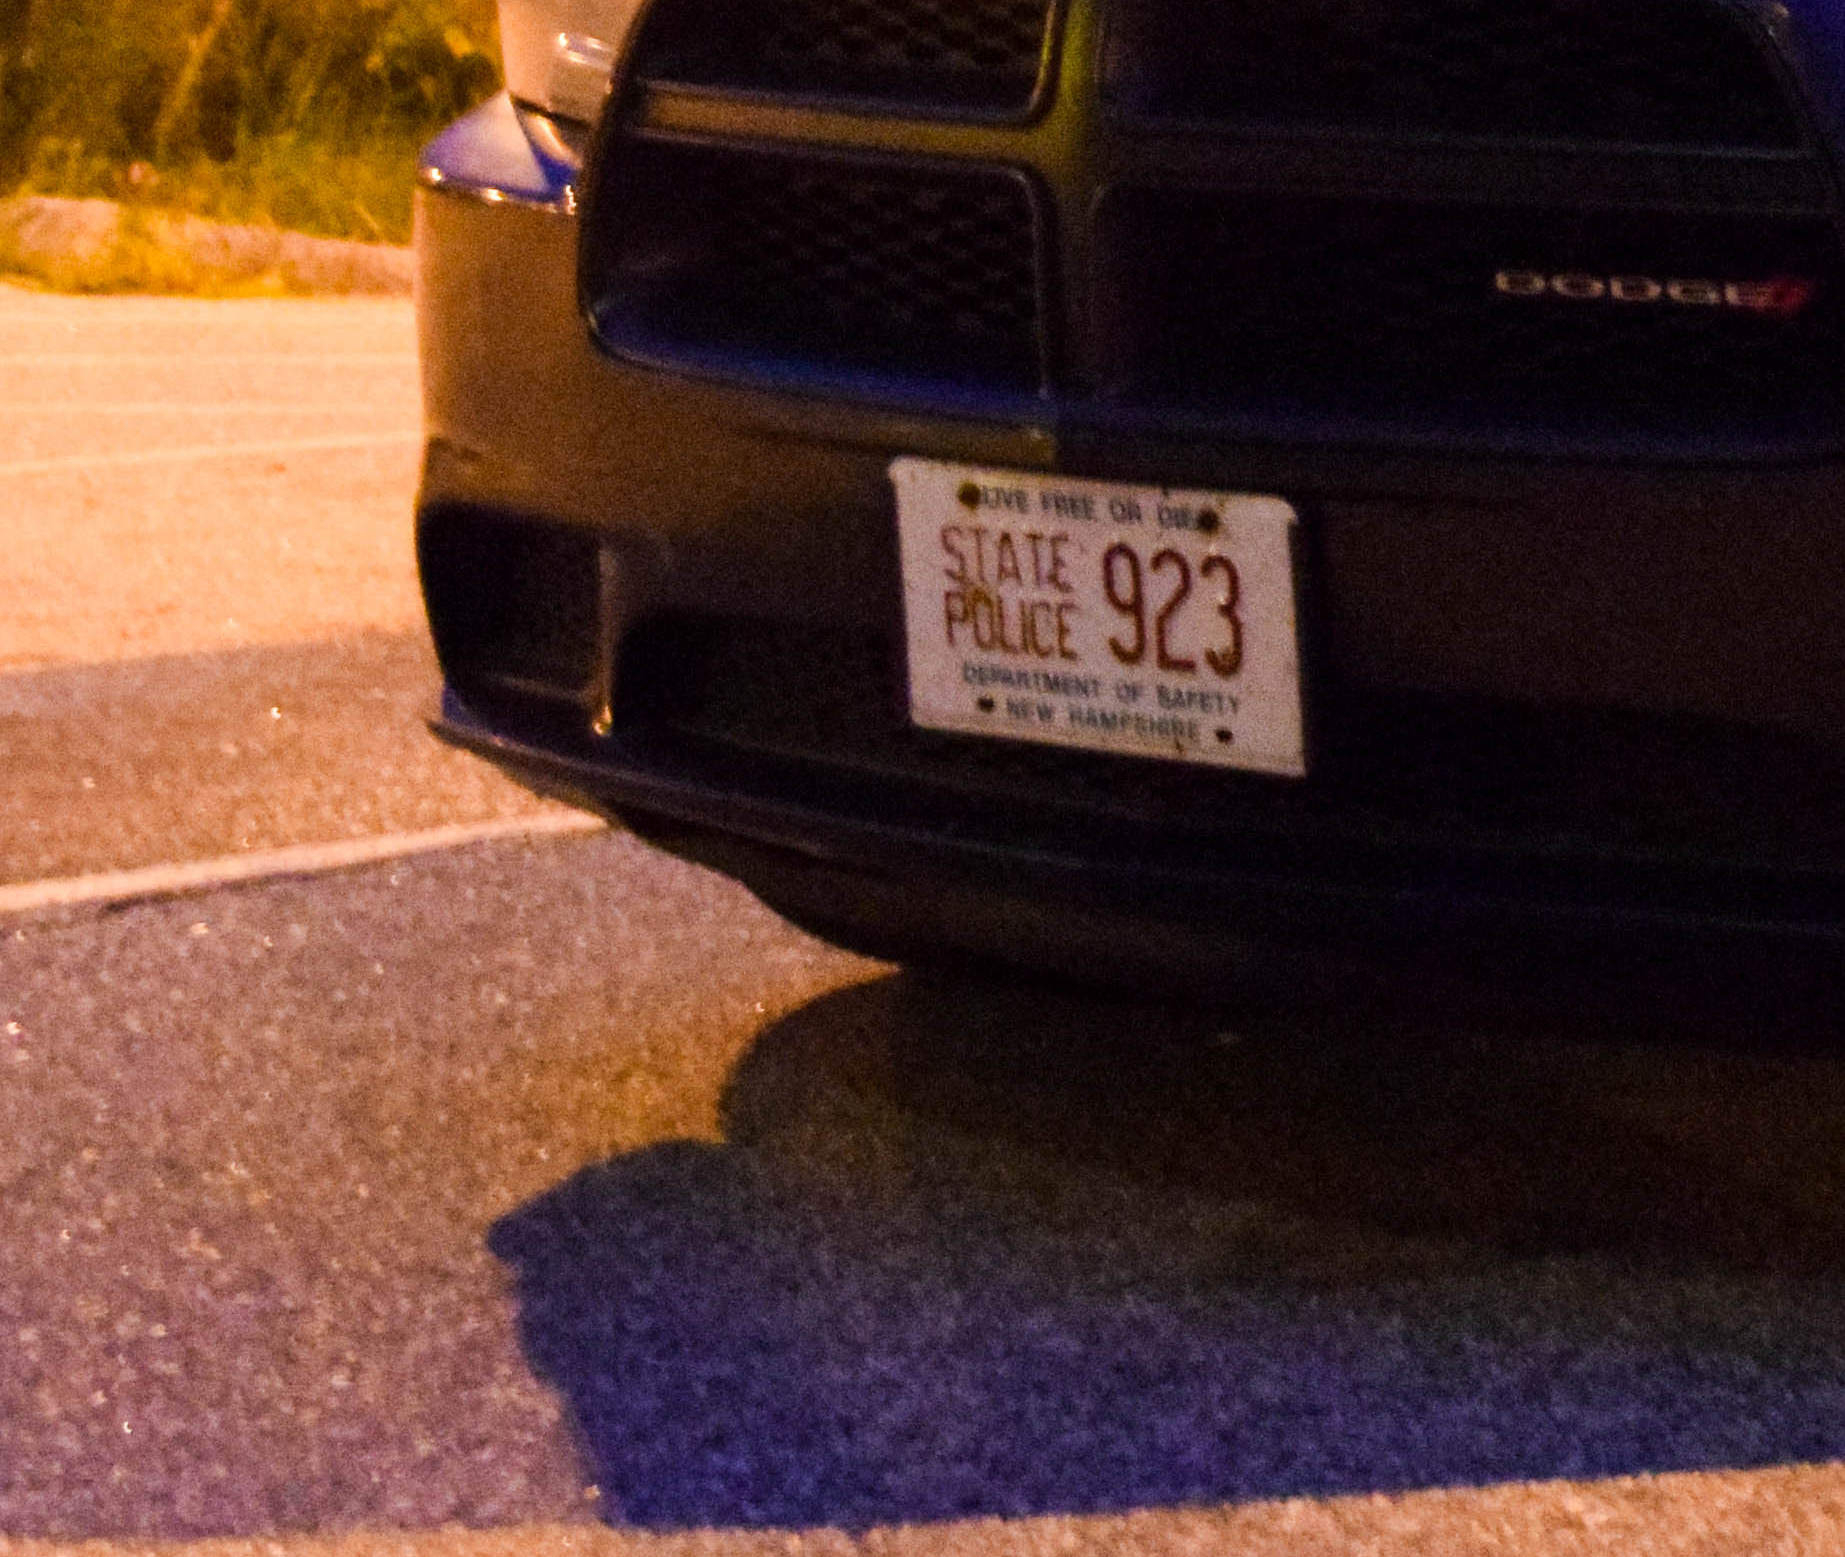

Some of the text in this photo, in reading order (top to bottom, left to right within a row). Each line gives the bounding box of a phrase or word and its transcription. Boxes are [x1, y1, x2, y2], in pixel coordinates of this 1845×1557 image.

[1495, 270, 1775, 308] DODGE
[1041, 490, 1096, 521] FREE
[1109, 498, 1142, 523] OR
[940, 525, 1074, 594] STATE
[944, 587, 1078, 662] POLICE
[1103, 542, 1243, 679] 923
[963, 661, 1240, 715] DEPARTMENT OF SAFETY
[1006, 698, 1200, 740] NEW HAMPSHIRE
